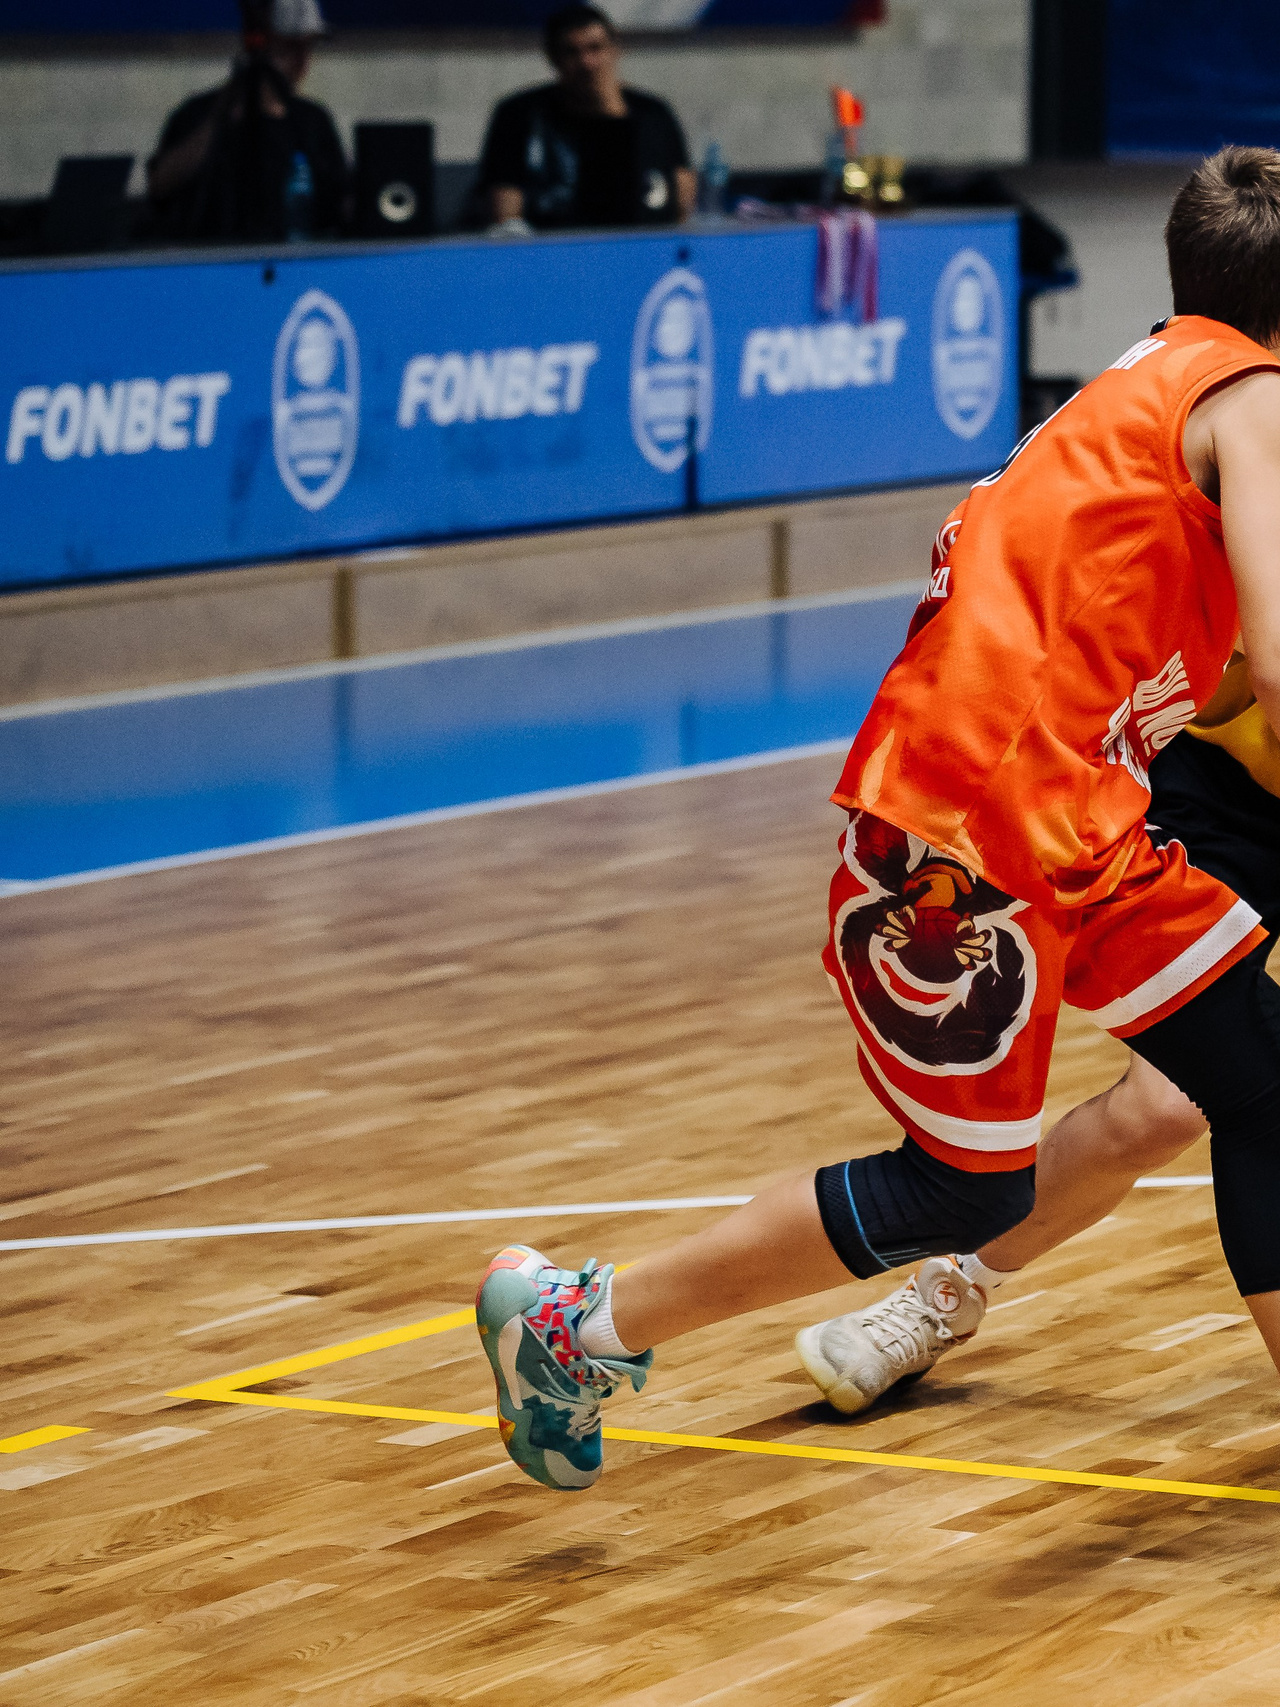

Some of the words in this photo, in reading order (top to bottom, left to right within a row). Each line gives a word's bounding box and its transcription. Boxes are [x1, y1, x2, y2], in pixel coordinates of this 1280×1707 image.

[400, 343, 597, 427] FONBET
[742, 319, 906, 396] FONBET
[7, 373, 230, 462] FONBET
